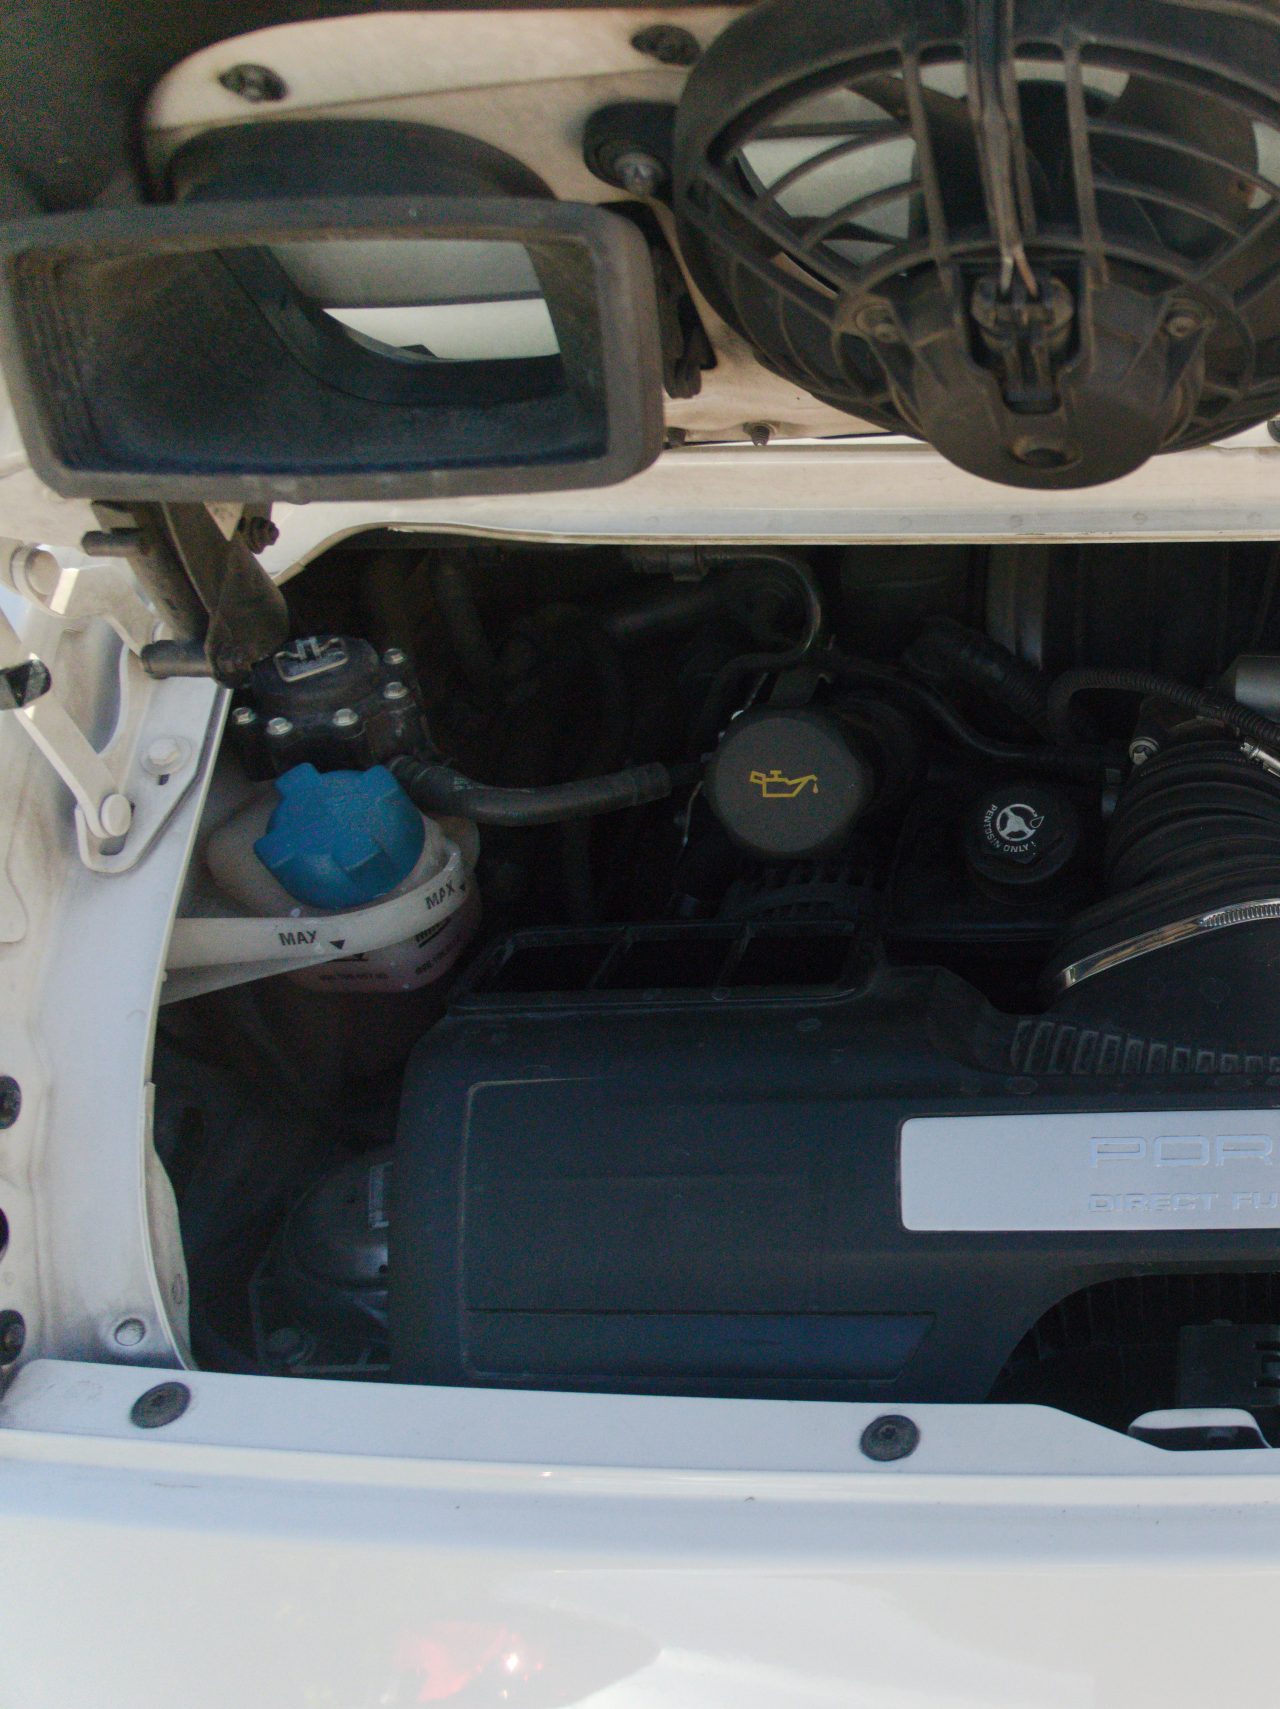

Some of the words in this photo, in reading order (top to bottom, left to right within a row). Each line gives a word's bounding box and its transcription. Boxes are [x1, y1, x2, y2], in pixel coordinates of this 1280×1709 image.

[983, 803, 1001, 848] PENTOSIN
[1003, 843, 1029, 853] ONLY
[1088, 1192, 1219, 1212] DIRECT
